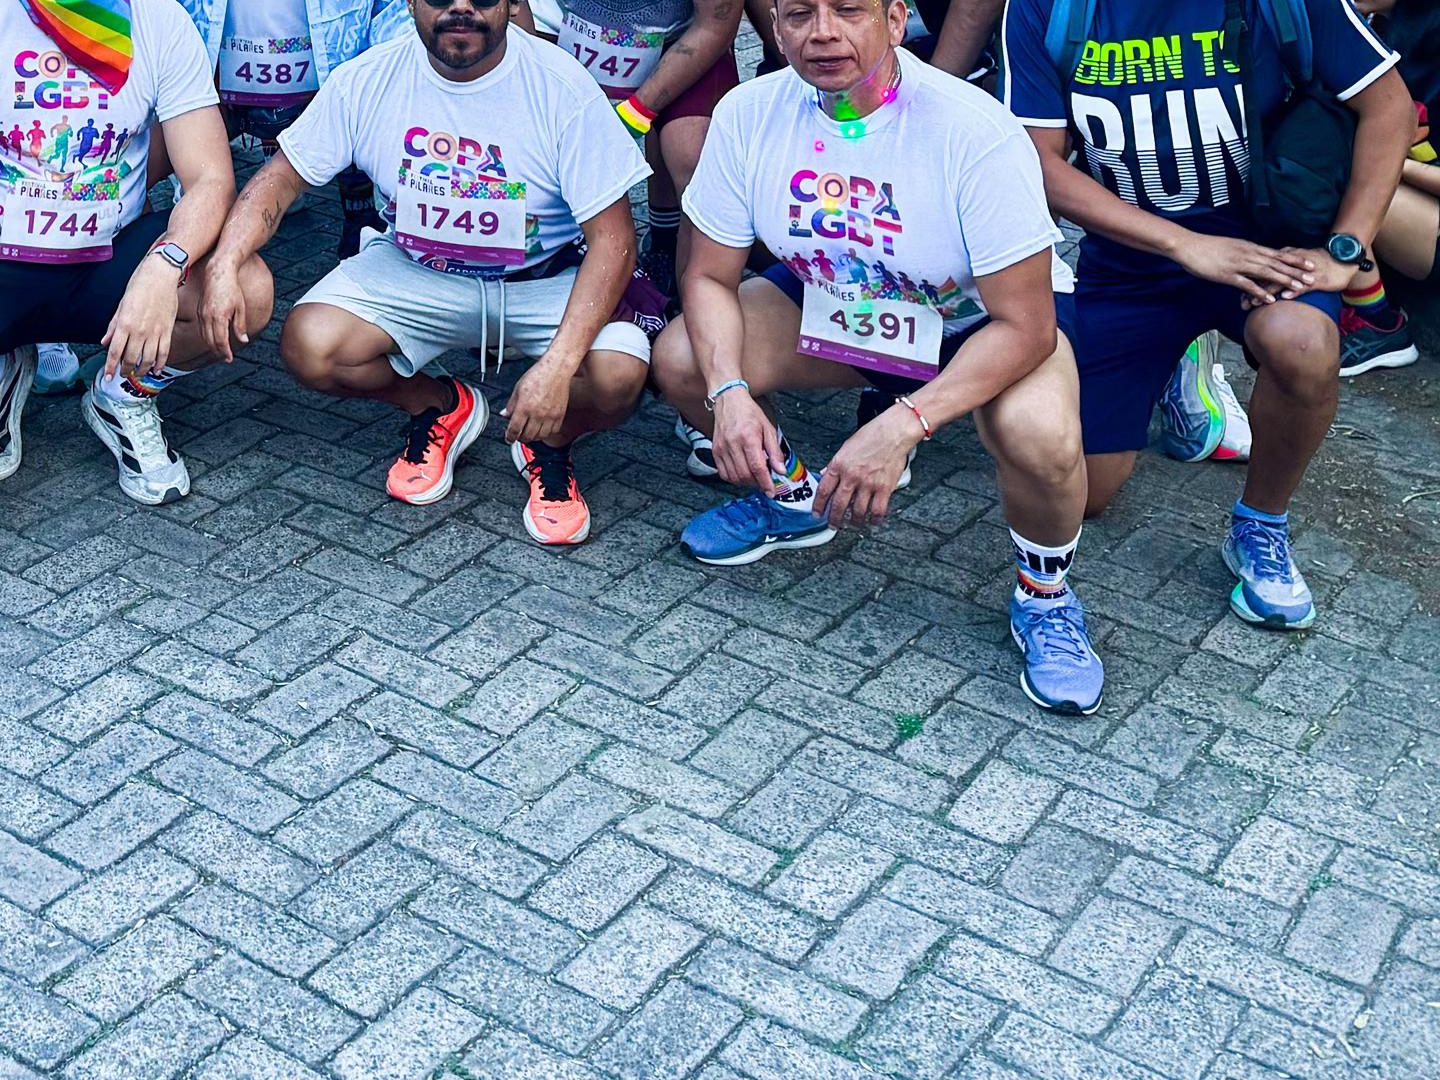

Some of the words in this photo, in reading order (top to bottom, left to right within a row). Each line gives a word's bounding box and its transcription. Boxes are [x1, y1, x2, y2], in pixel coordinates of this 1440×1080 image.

[14, 50, 79, 79] CO
[231, 42, 264, 54] PILARES
[573, 42, 641, 79] 1747
[1074, 34, 1185, 86] BORN
[235, 60, 311, 85] 4387
[404, 126, 508, 178] COPA
[1070, 83, 1252, 212] RUN
[20, 186, 58, 200] PILARES
[410, 178, 446, 197] PILARES
[789, 169, 901, 222] COPA
[24, 209, 99, 237] 1744
[417, 202, 500, 236] 1749
[788, 204, 903, 257] LGBT
[829, 309, 916, 345] 4391
